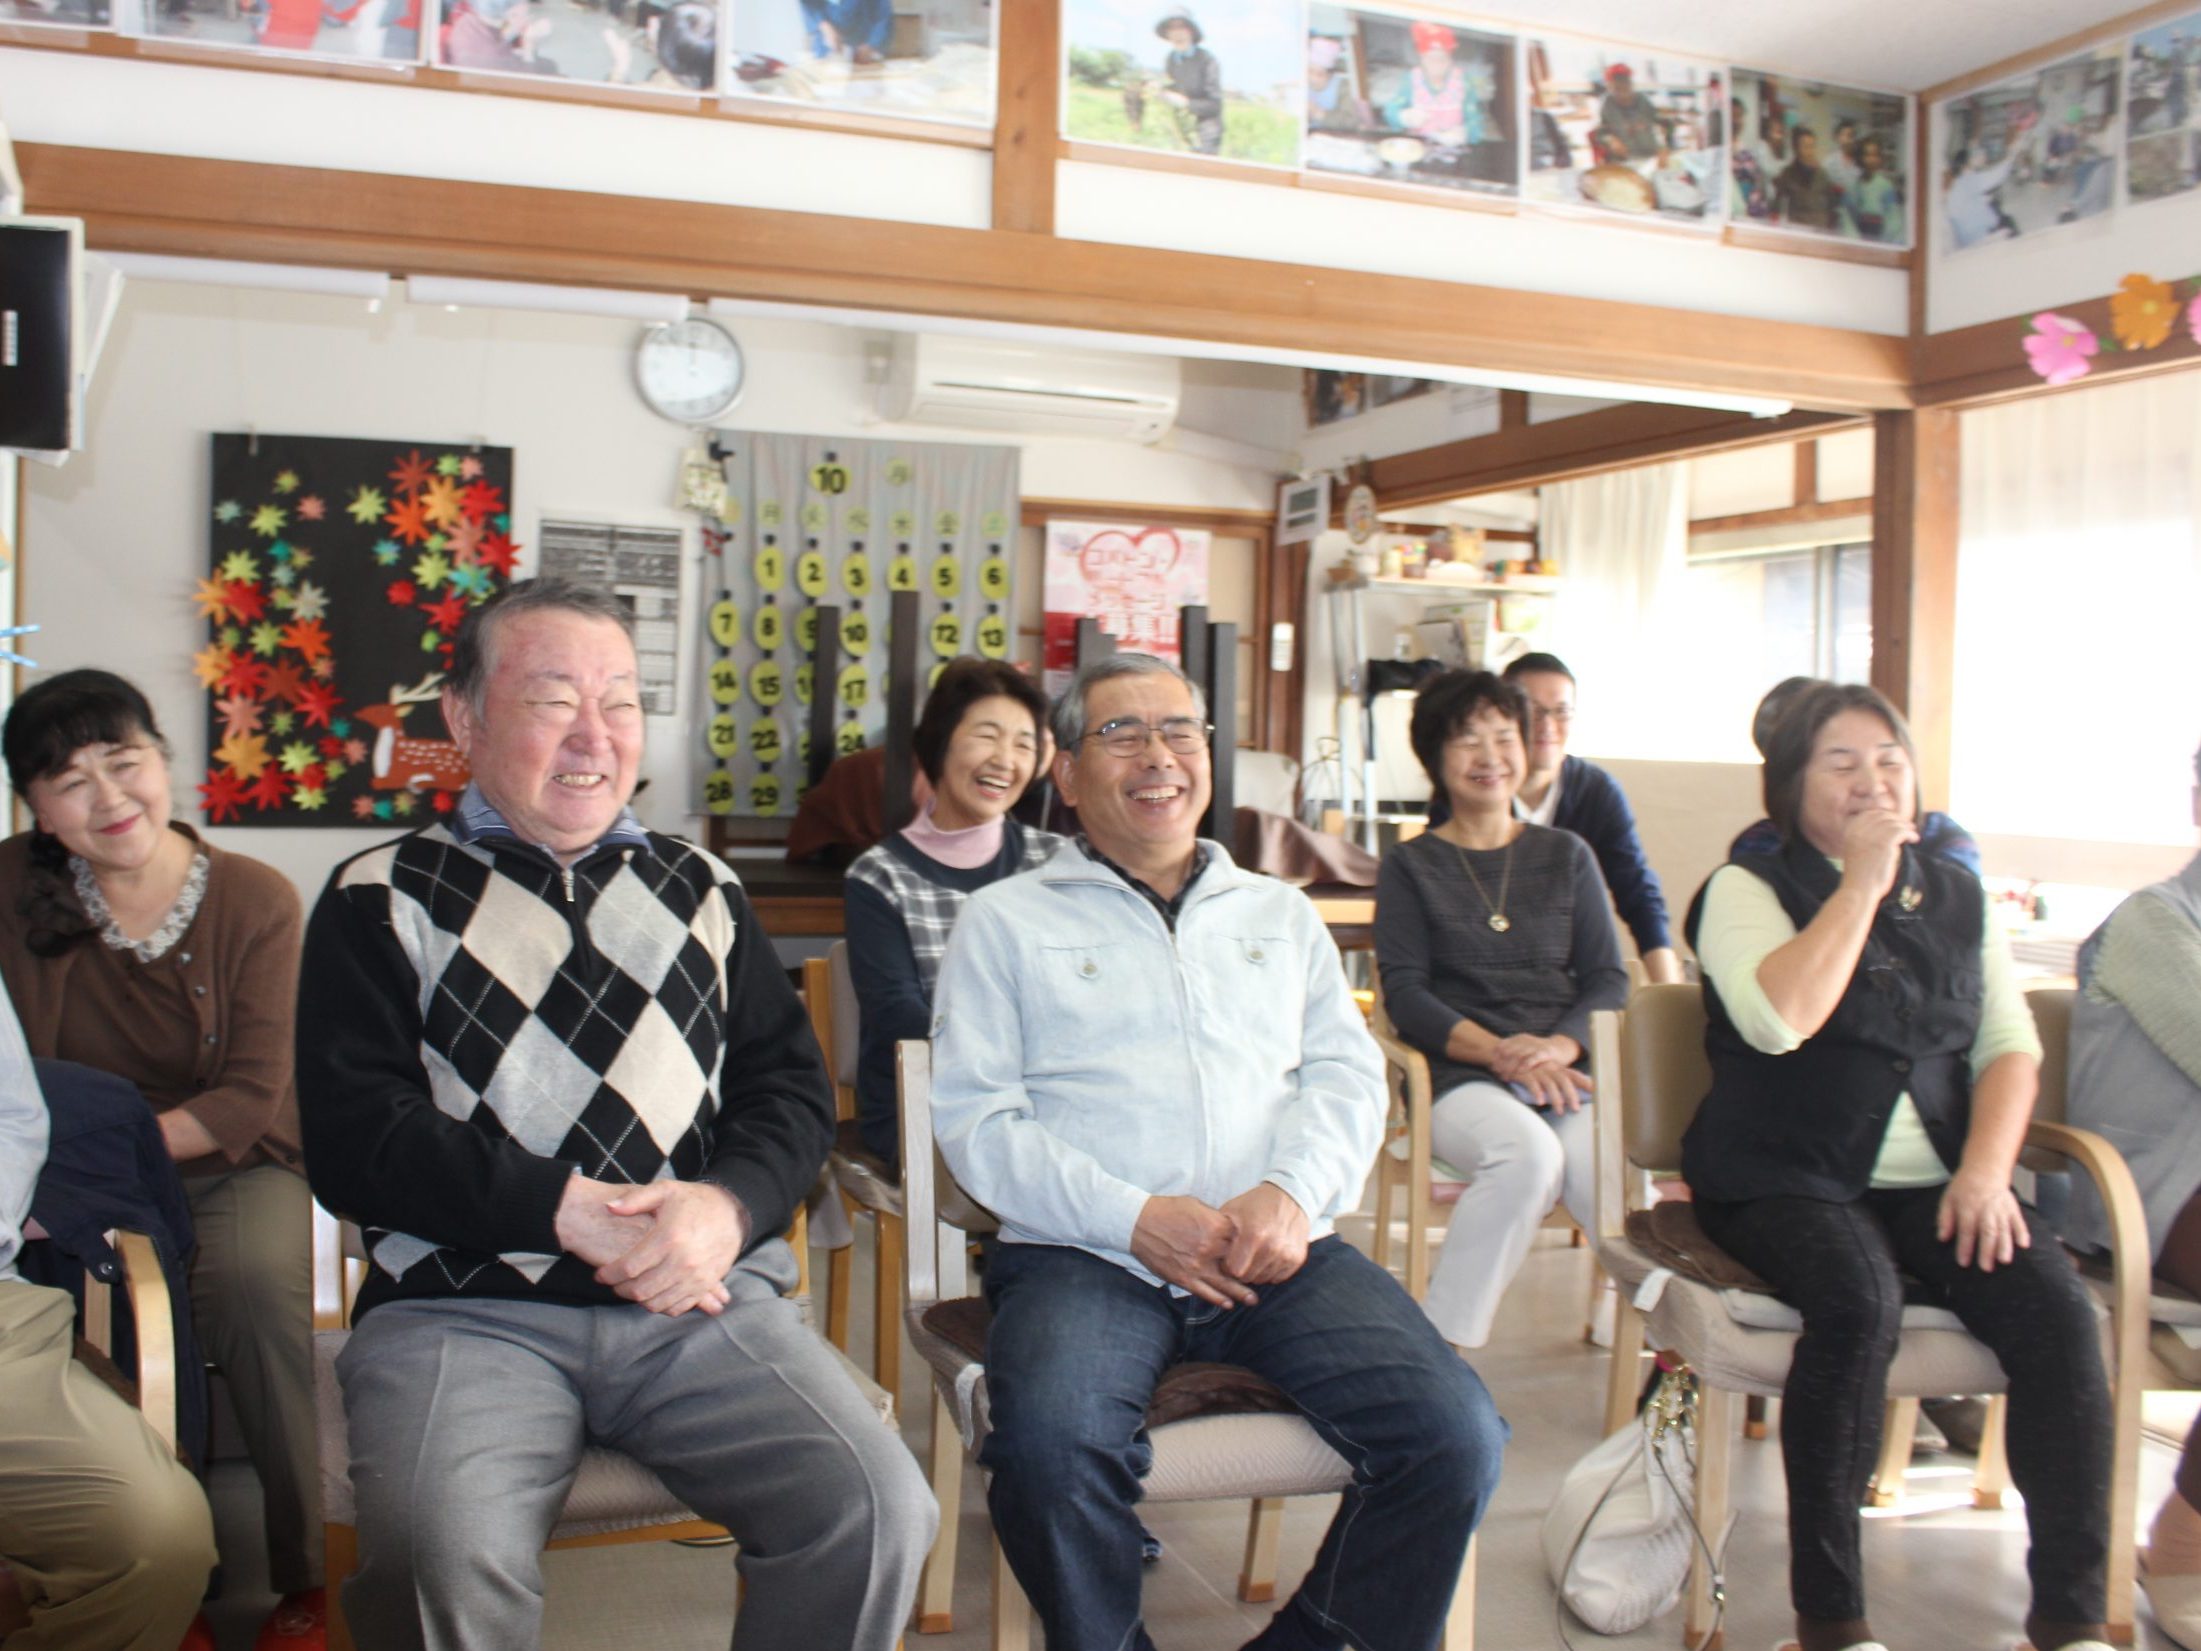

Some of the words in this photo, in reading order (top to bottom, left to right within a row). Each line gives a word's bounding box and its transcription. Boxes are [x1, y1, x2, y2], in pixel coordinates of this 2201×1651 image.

[815, 467, 846, 495] 10
[764, 559, 775, 578] 1
[807, 562, 822, 583] 2
[849, 568, 865, 587] 3
[895, 568, 910, 587] 4
[939, 568, 953, 587] 5
[986, 568, 1002, 586] 6
[718, 613, 733, 634] 7
[762, 617, 776, 637] 8
[845, 624, 868, 643] 10
[936, 624, 959, 645] 12
[982, 629, 1004, 648] 13
[712, 672, 737, 692] 14
[758, 676, 780, 697] 15
[844, 680, 867, 701] 17
[714, 724, 735, 745] 21
[752, 730, 780, 750] 22
[706, 781, 733, 803] 28
[752, 786, 778, 807] 29
